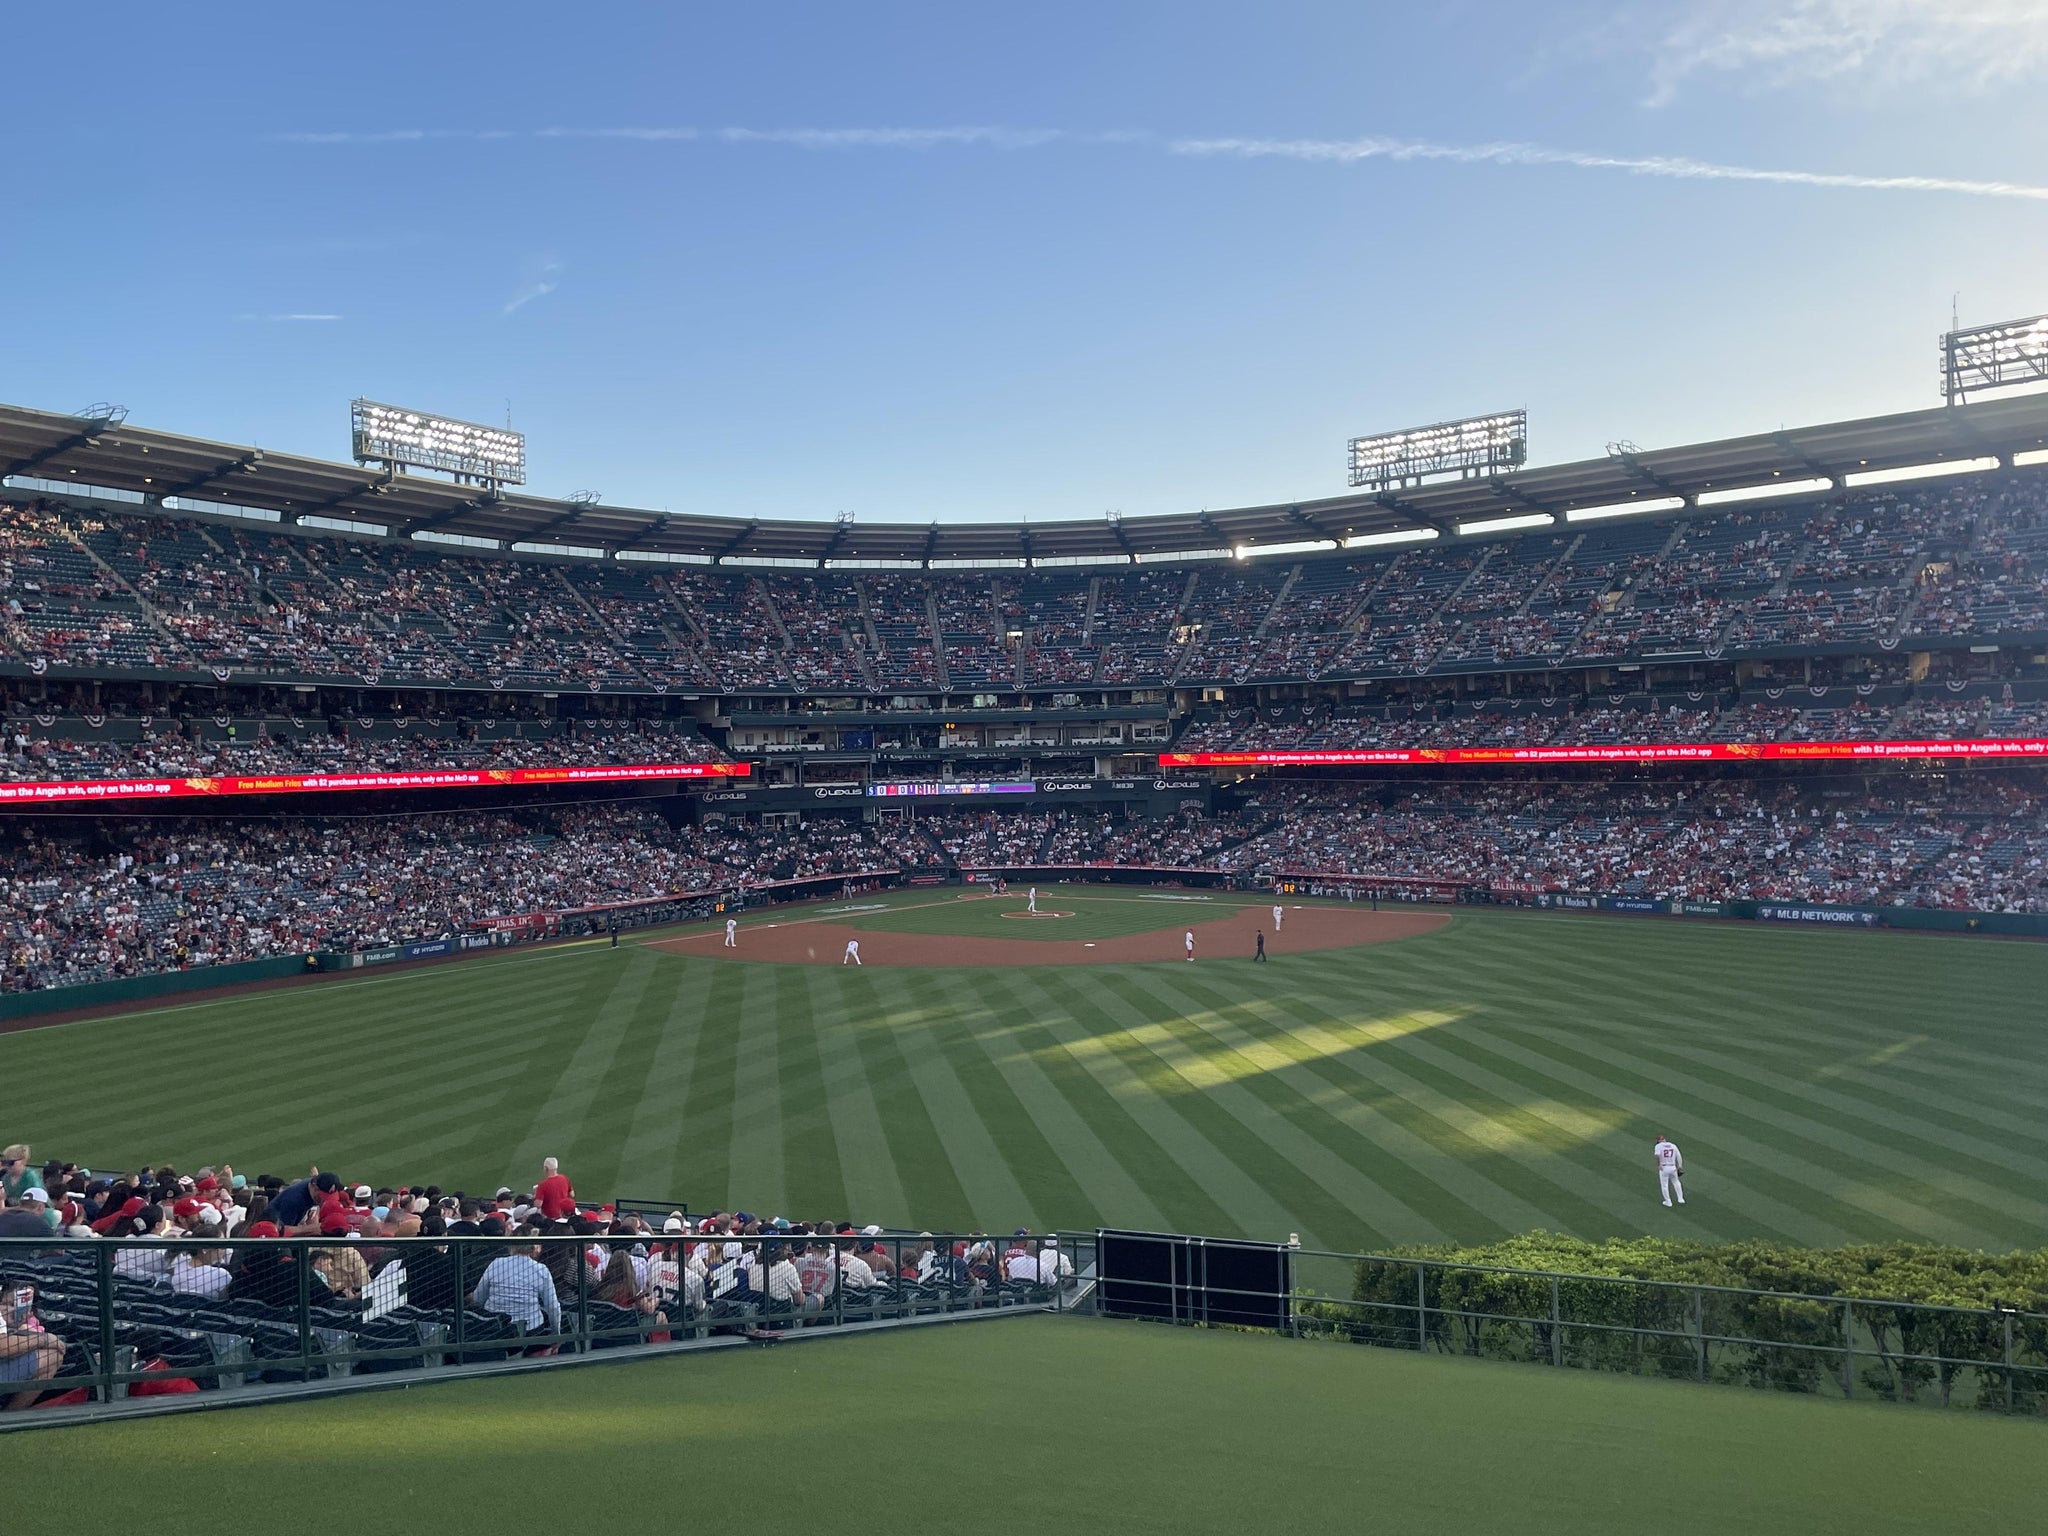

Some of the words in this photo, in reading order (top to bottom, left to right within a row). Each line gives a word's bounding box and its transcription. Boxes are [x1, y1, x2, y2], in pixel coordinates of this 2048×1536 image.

[1854, 746, 1872, 754] with
[1873, 744, 1884, 754] $2
[1886, 746, 1926, 754] purchase
[1927, 744, 1952, 752] when
[1953, 744, 1969, 752] the
[1970, 744, 2003, 754] Angels
[2024, 744, 2044, 752] only
[238, 780, 254, 788] Free
[255, 780, 283, 788] Medium
[285, 780, 301, 788] Fries
[302, 778, 318, 786] with
[319, 778, 327, 786] $2
[328, 778, 358, 786] purchase
[377, 776, 388, 784] the
[389, 776, 409, 784] Angels
[423, 776, 435, 784] only
[445, 774, 454, 782] the
[0, 788, 16, 796] hen
[18, 788, 33, 796] the
[35, 786, 66, 798] Angels
[87, 784, 105, 796] only
[107, 786, 118, 794] on
[120, 784, 133, 792] the
[135, 784, 153, 792] McD
[155, 784, 171, 794] app
[1565, 898, 1588, 907] Modelo
[1686, 906, 1718, 914] FMB.com
[1777, 910, 1800, 919] MLB
[1802, 911, 1854, 922] NETWORK
[468, 937, 489, 948] Modelo
[422, 944, 445, 953] HYUNDAI
[366, 952, 396, 961] FMB.com
[1663, 1149, 1674, 1158] 27
[802, 1270, 828, 1292] 27
